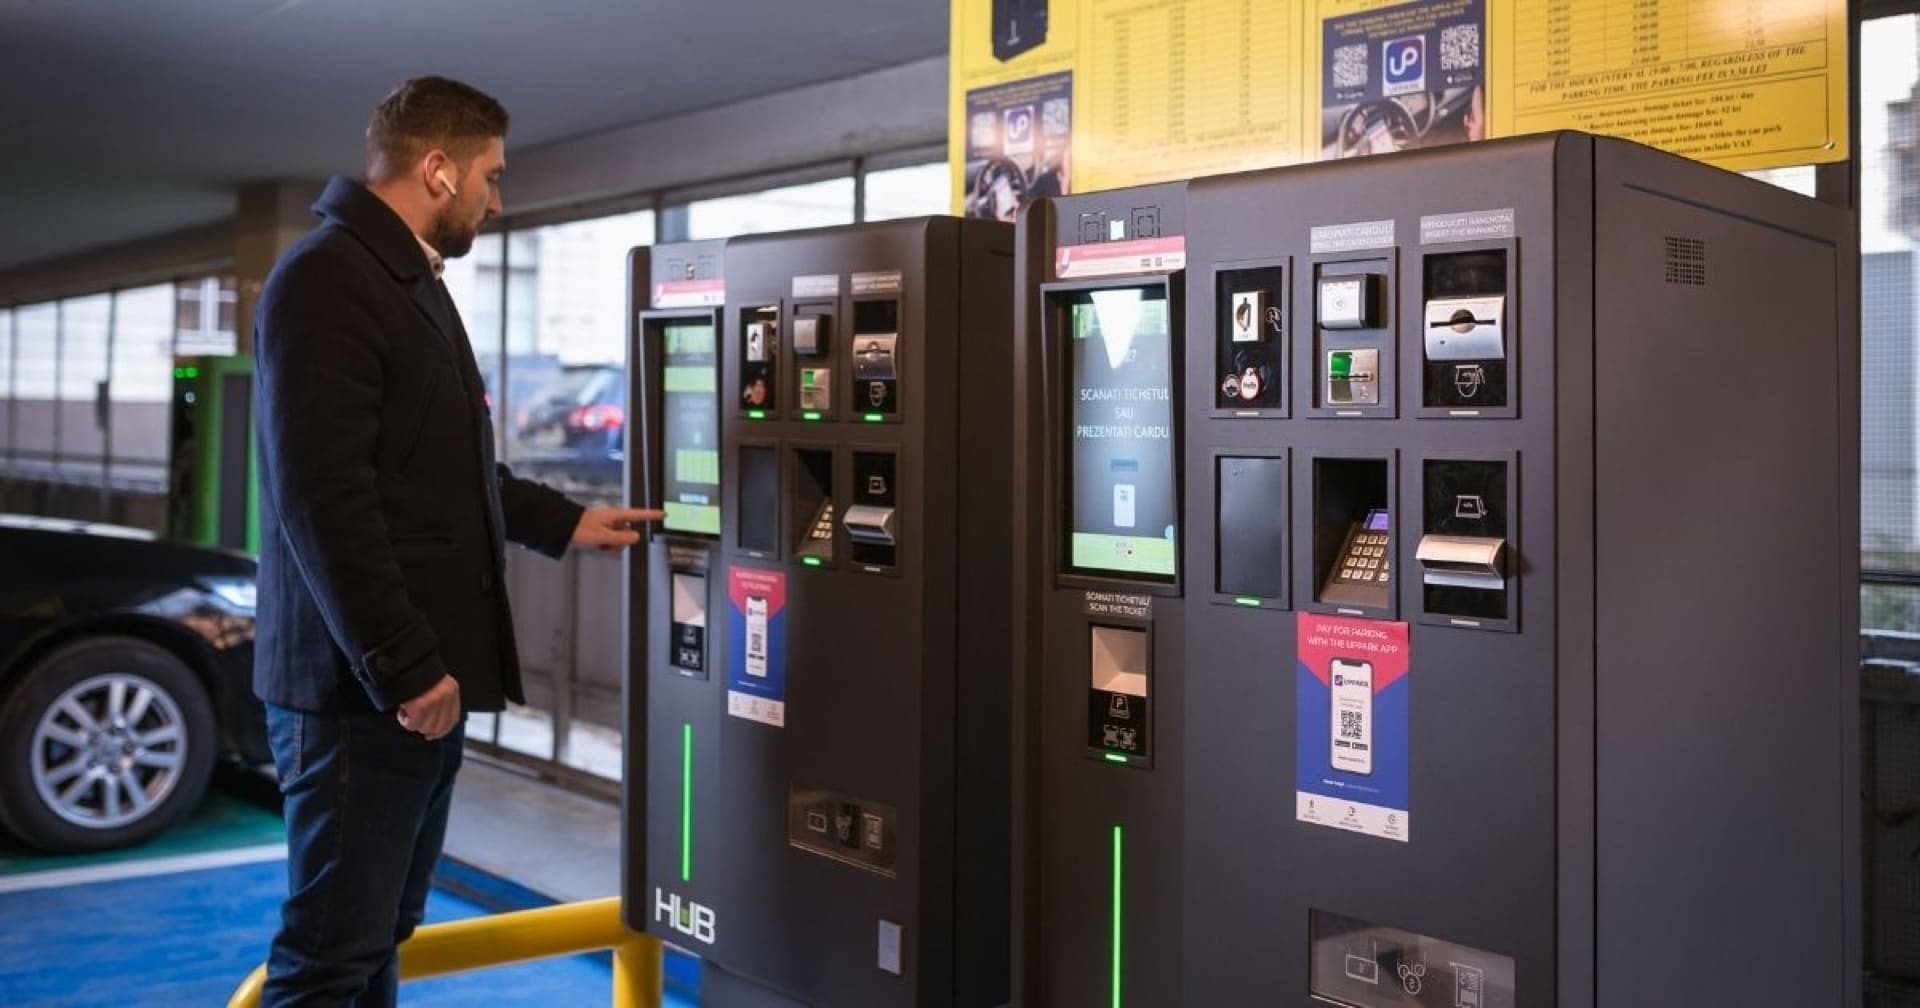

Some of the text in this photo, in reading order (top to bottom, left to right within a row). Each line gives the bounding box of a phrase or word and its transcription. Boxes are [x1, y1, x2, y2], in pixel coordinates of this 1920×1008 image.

[1701, 50, 1766, 68] REGARDLESS
[1767, 50, 1781, 59] OF
[1786, 46, 1805, 55] THE
[1562, 87, 1600, 100] PARKING
[1631, 81, 1648, 91] THE
[1652, 75, 1692, 88] PARKING
[1696, 72, 1714, 82] FEE
[1710, 130, 1733, 139] within
[1736, 128, 1747, 136] the
[1749, 127, 1761, 135] car
[1763, 124, 1782, 135] park
[1124, 388, 1168, 400] TICHETUL
[1115, 407, 1134, 419] SAU
[1089, 602, 1148, 616] SCAN THE TICKET
[1316, 624, 1388, 640] PAY FOR PARKING
[1307, 636, 1398, 654] WITH THE UPPARK APP
[655, 887, 716, 944] HUB
